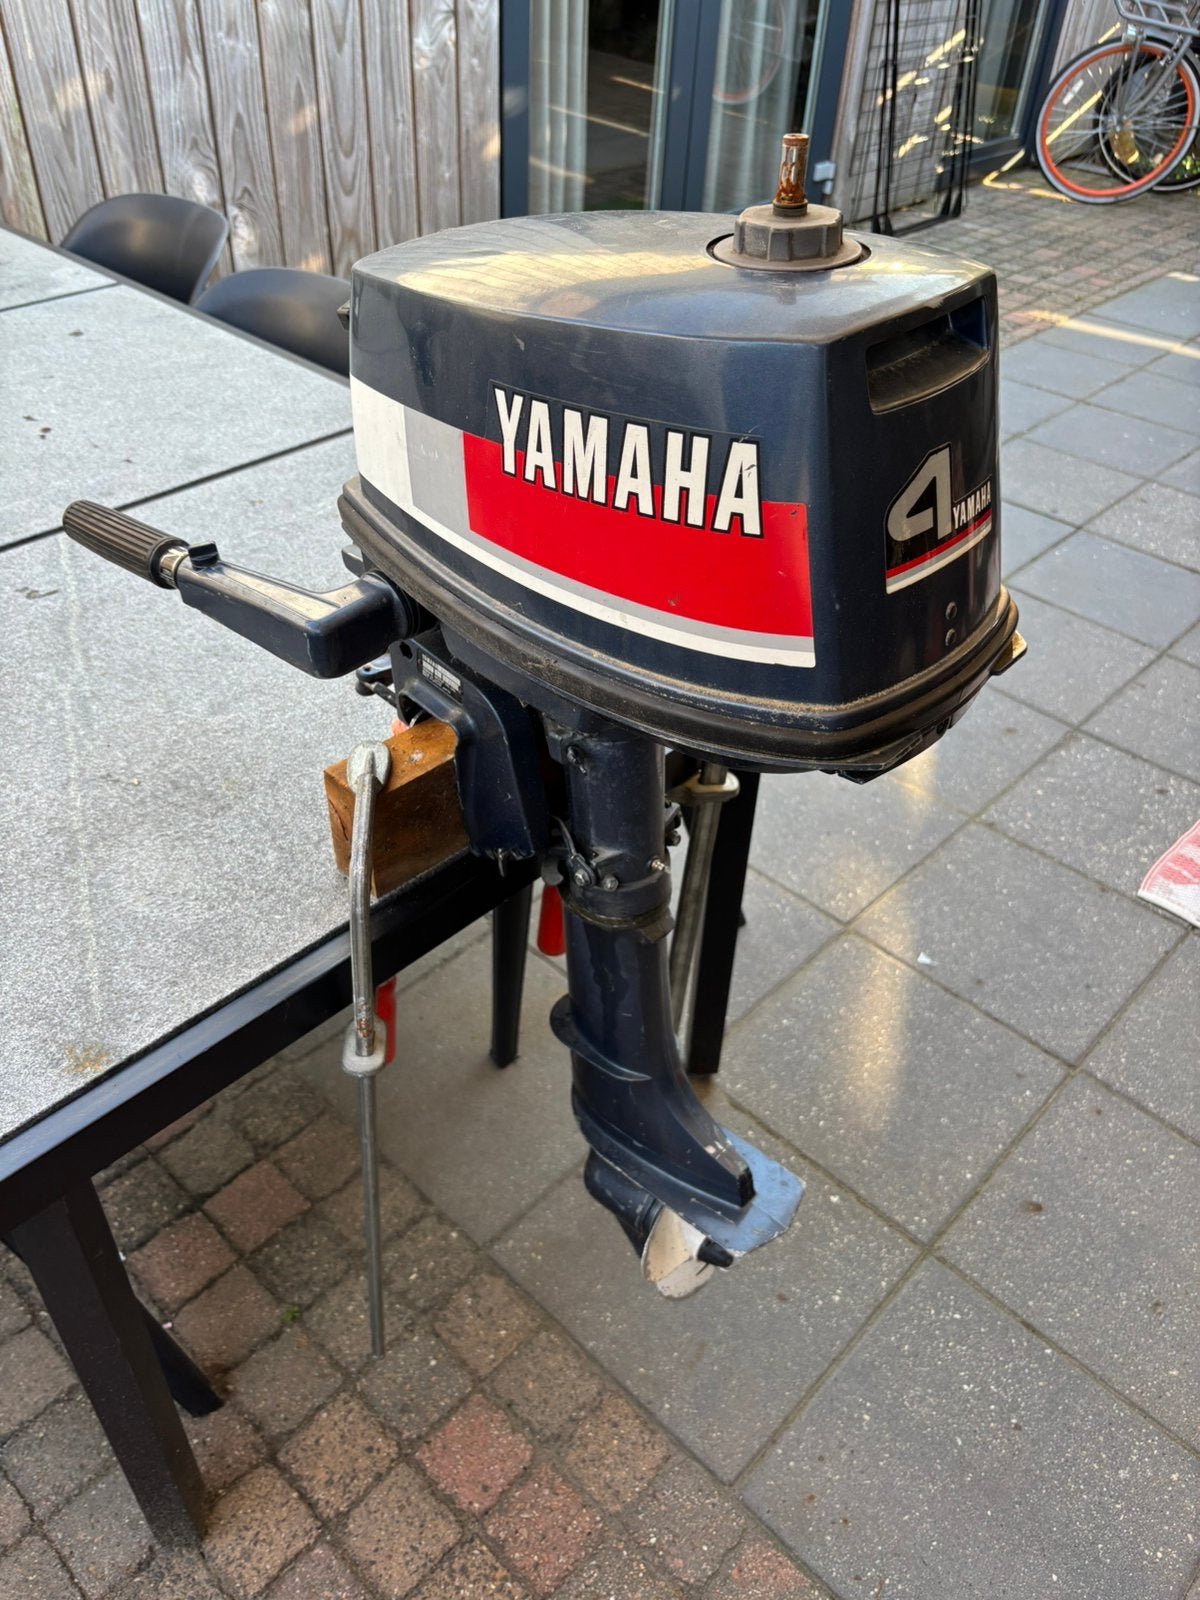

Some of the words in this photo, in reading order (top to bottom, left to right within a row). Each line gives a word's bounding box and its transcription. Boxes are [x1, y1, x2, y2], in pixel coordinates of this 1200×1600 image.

[493, 387, 763, 538] YAMAHA
[887, 446, 953, 542] 4
[952, 480, 992, 530] YAMAHA
